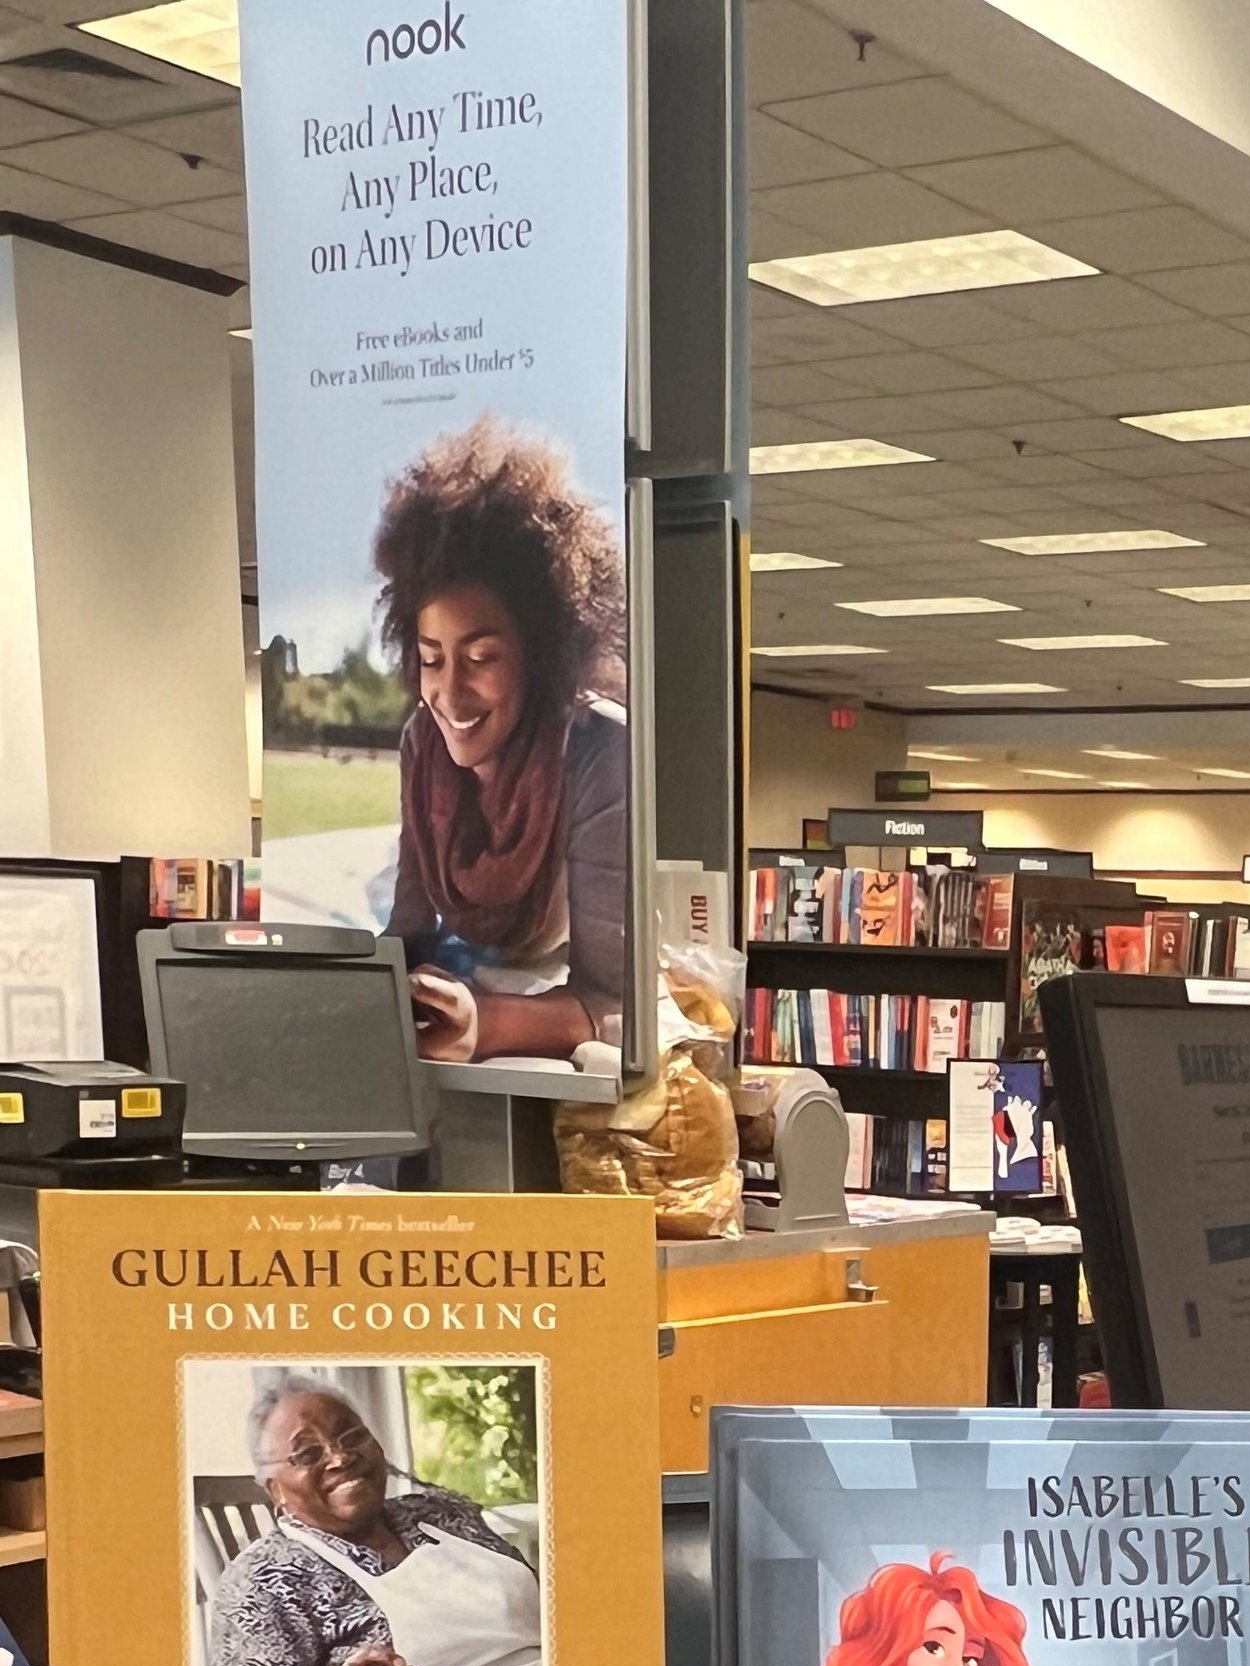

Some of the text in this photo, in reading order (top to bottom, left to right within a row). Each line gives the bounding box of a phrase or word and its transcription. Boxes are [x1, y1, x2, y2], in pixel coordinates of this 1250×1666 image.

[366, 0, 466, 66] nook
[303, 90, 543, 158] Read Any Time,
[340, 155, 499, 219] Any Place,
[310, 213, 533, 277] on Any Device
[356, 318, 483, 352] Free eBooks and
[310, 347, 535, 389] Over a Million Titles Under $5
[690, 895, 709, 934] BUY
[247, 1216, 262, 1232] A
[267, 1216, 304, 1232] New
[347, 1215, 392, 1233] Times
[112, 1249, 607, 1288] GULLAH GEECHEE
[168, 1302, 559, 1331] HOME COOKING
[1028, 1475, 1245, 1518] ISABELLE’S
[1042, 1596, 1245, 1641] NEIGHBOR
